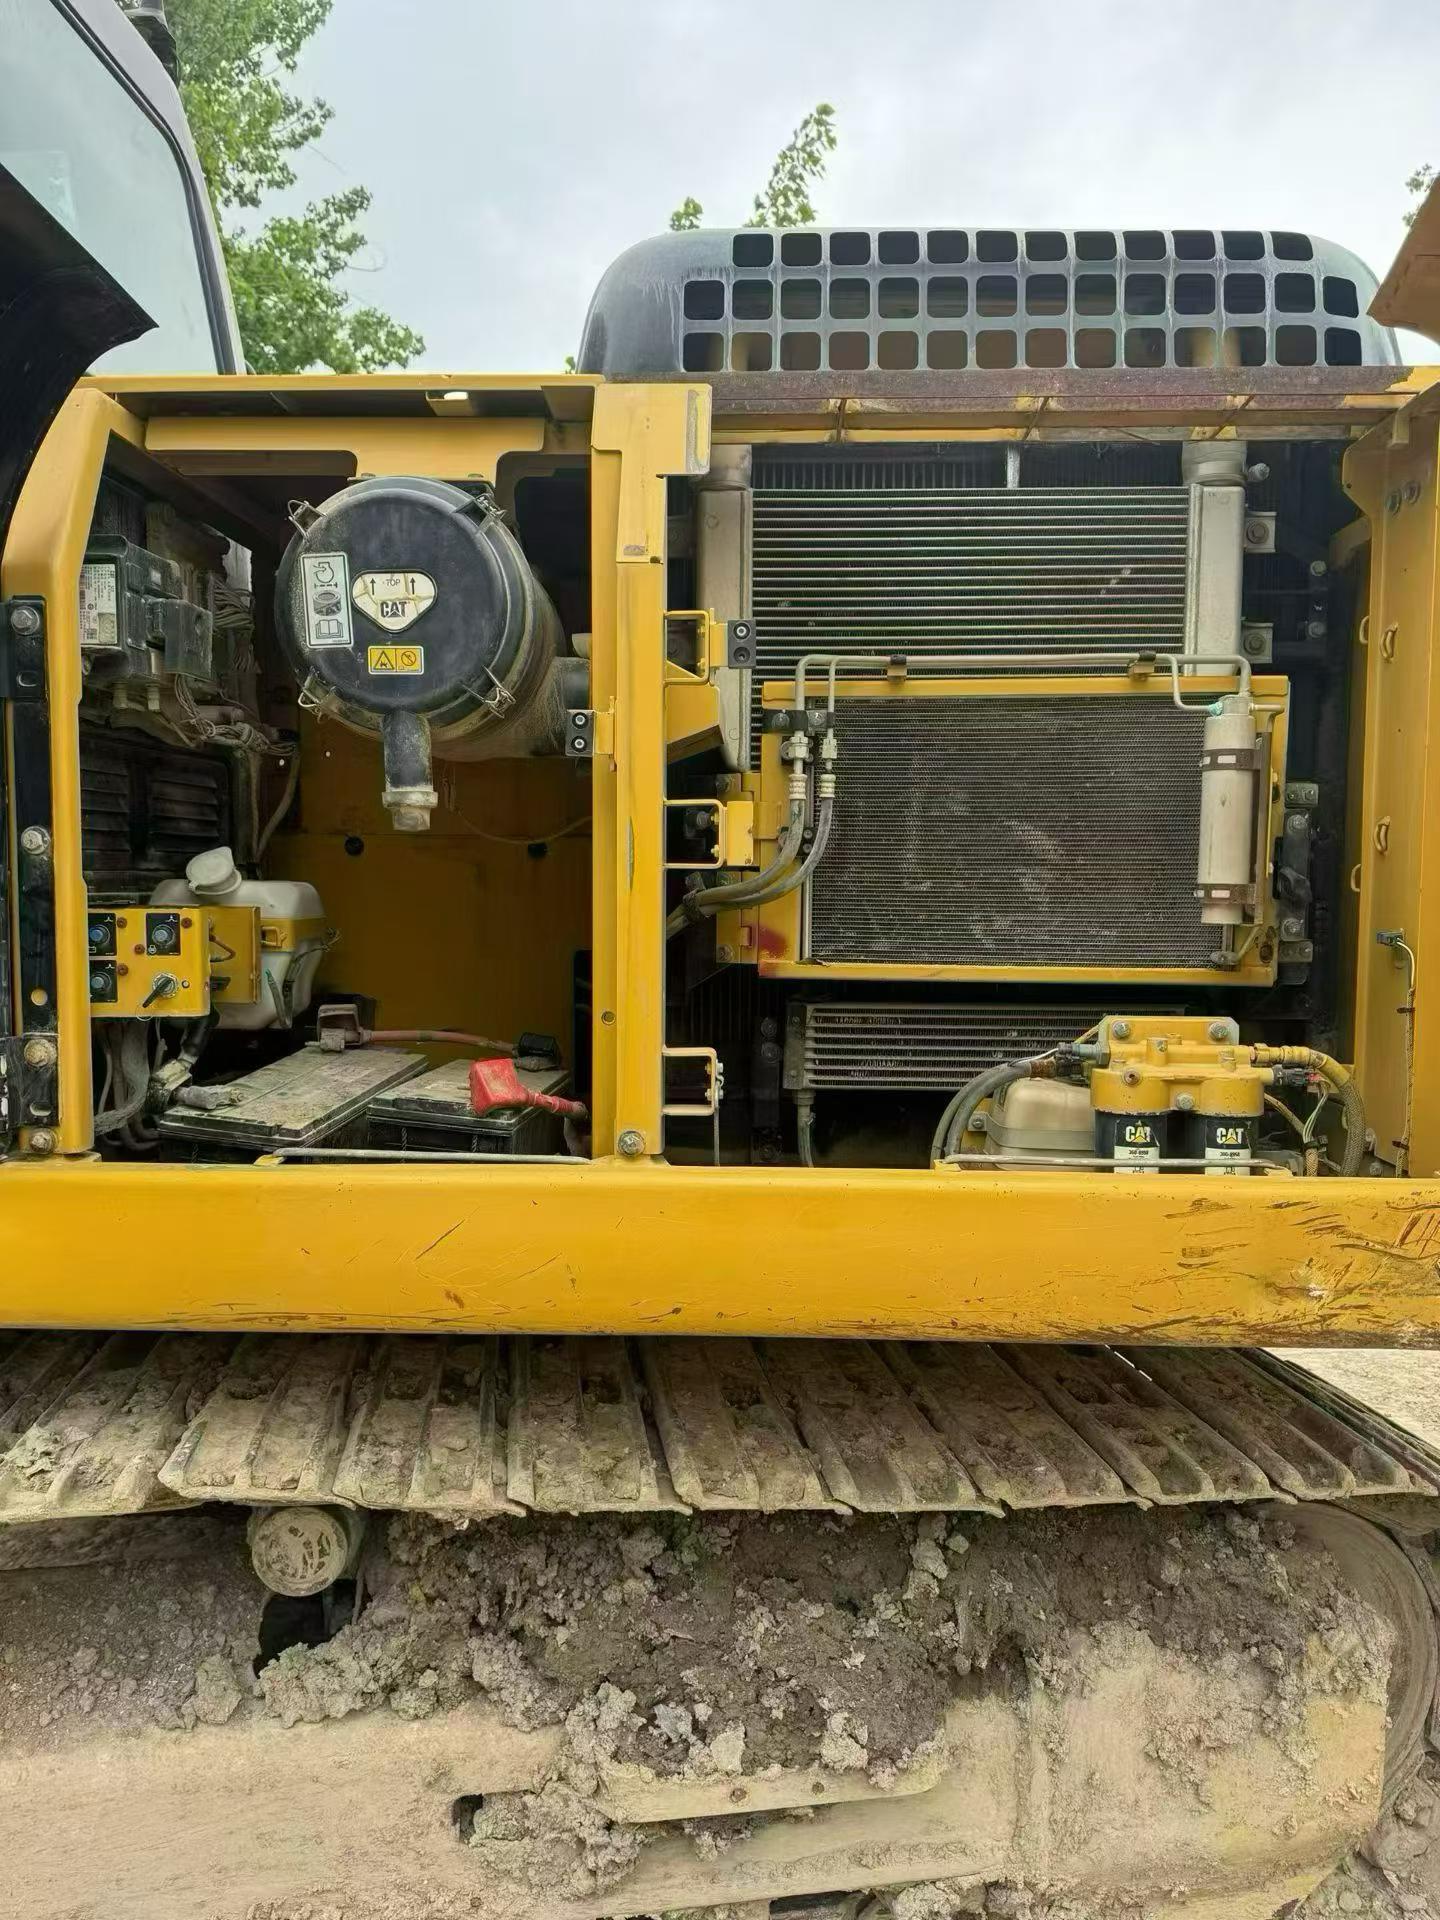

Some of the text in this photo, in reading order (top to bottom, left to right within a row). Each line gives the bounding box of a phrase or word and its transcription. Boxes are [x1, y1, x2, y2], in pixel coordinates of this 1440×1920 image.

[386, 578, 401, 587] TOP
[380, 601, 407, 618] CAT
[1125, 1125, 1151, 1143] CAT
[1216, 1127, 1244, 1145] CAT
